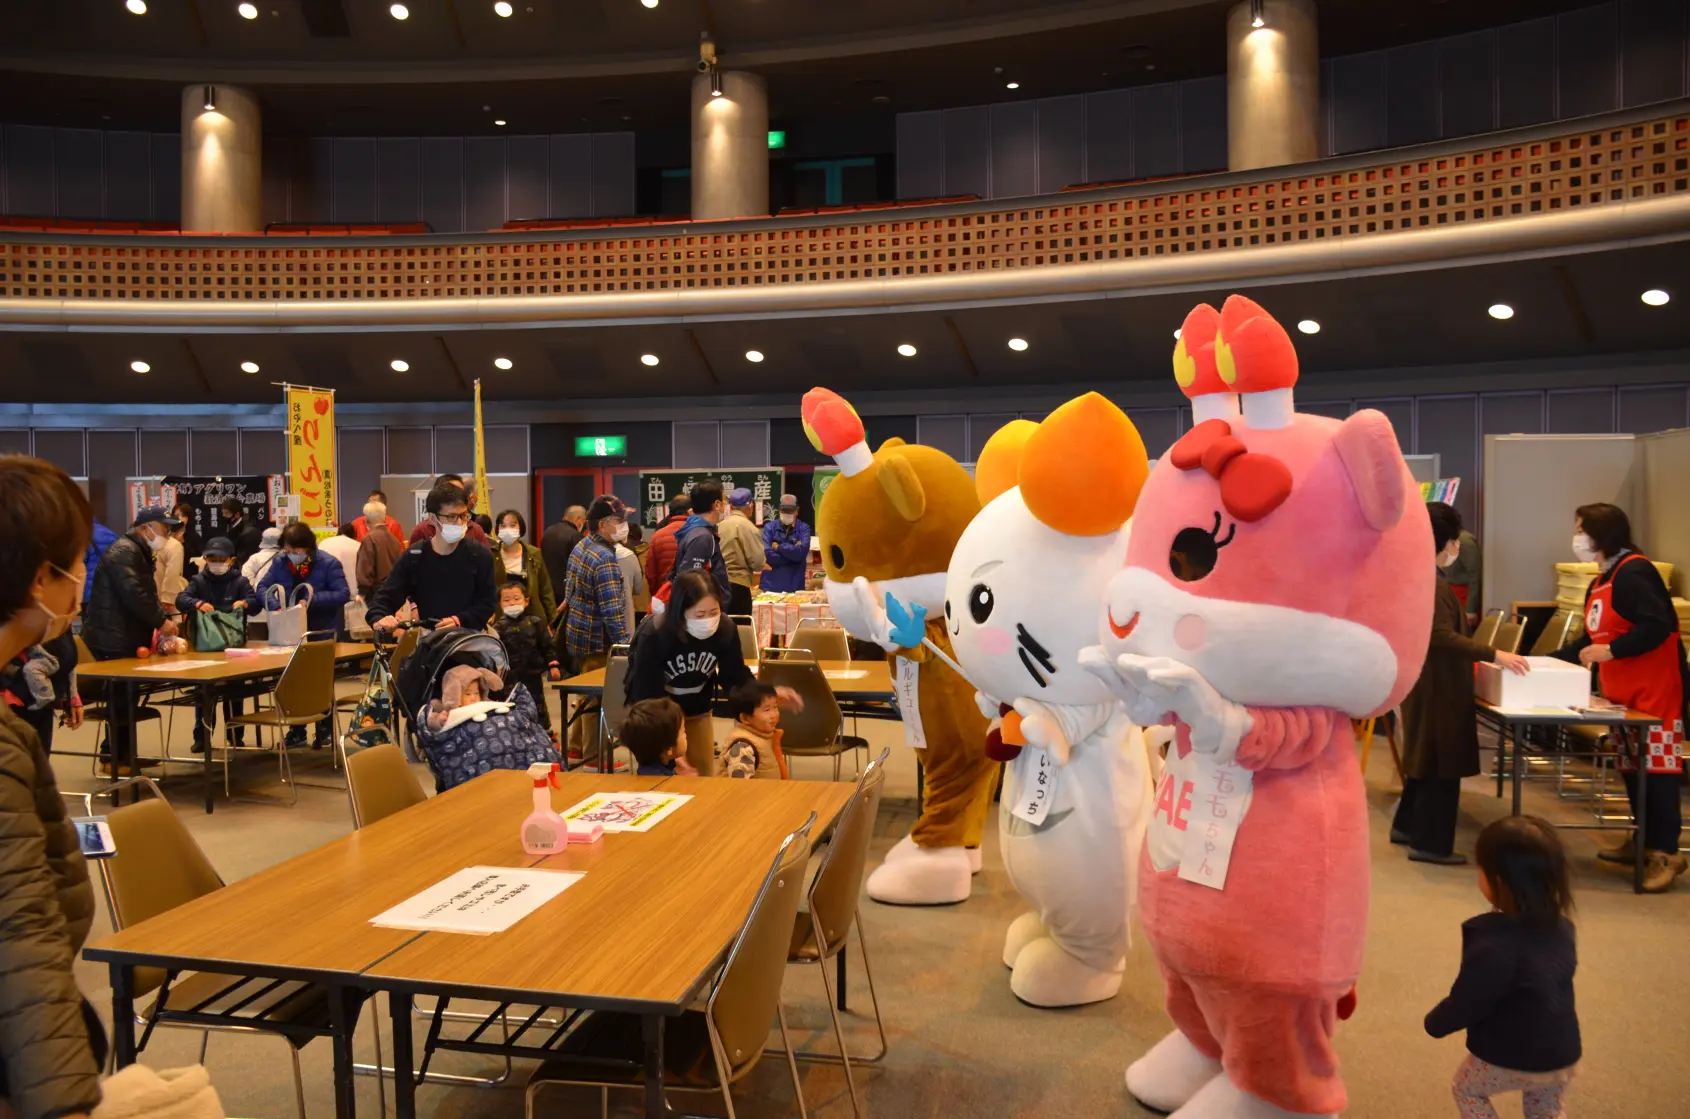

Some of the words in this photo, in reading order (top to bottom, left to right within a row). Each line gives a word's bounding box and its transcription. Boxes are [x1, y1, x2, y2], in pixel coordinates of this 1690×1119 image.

[257, 506, 265, 520] パン
[1027, 754, 1050, 815] いなっち
